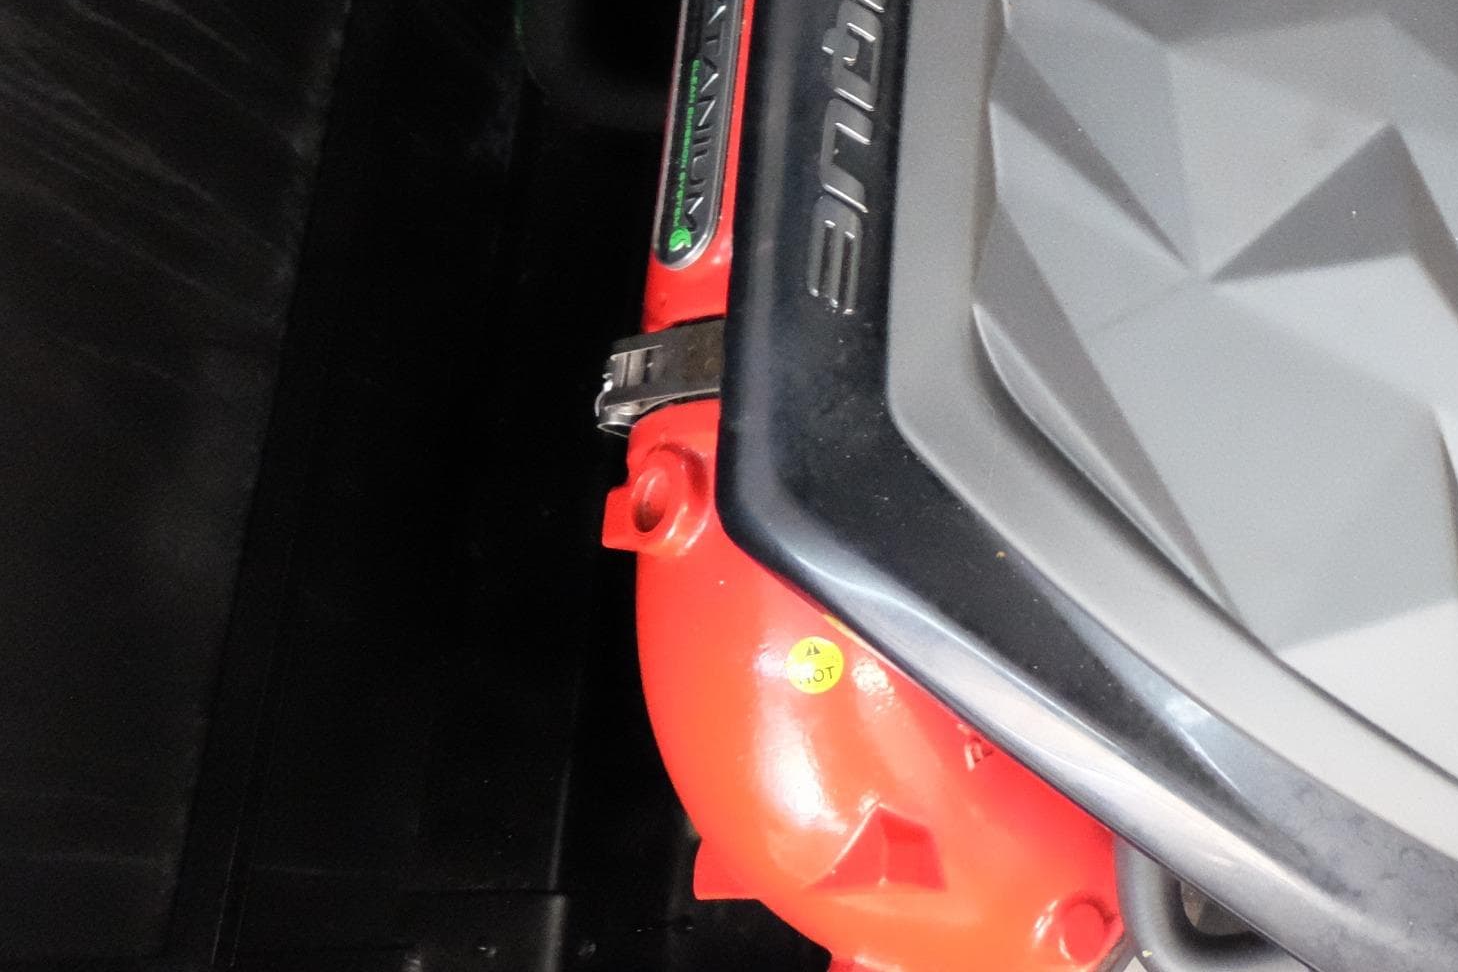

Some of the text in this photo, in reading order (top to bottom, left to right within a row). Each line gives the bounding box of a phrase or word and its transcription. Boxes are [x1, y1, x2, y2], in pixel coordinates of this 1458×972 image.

[673, 59, 700, 228] CLEAN EMISSION SYSTEM
